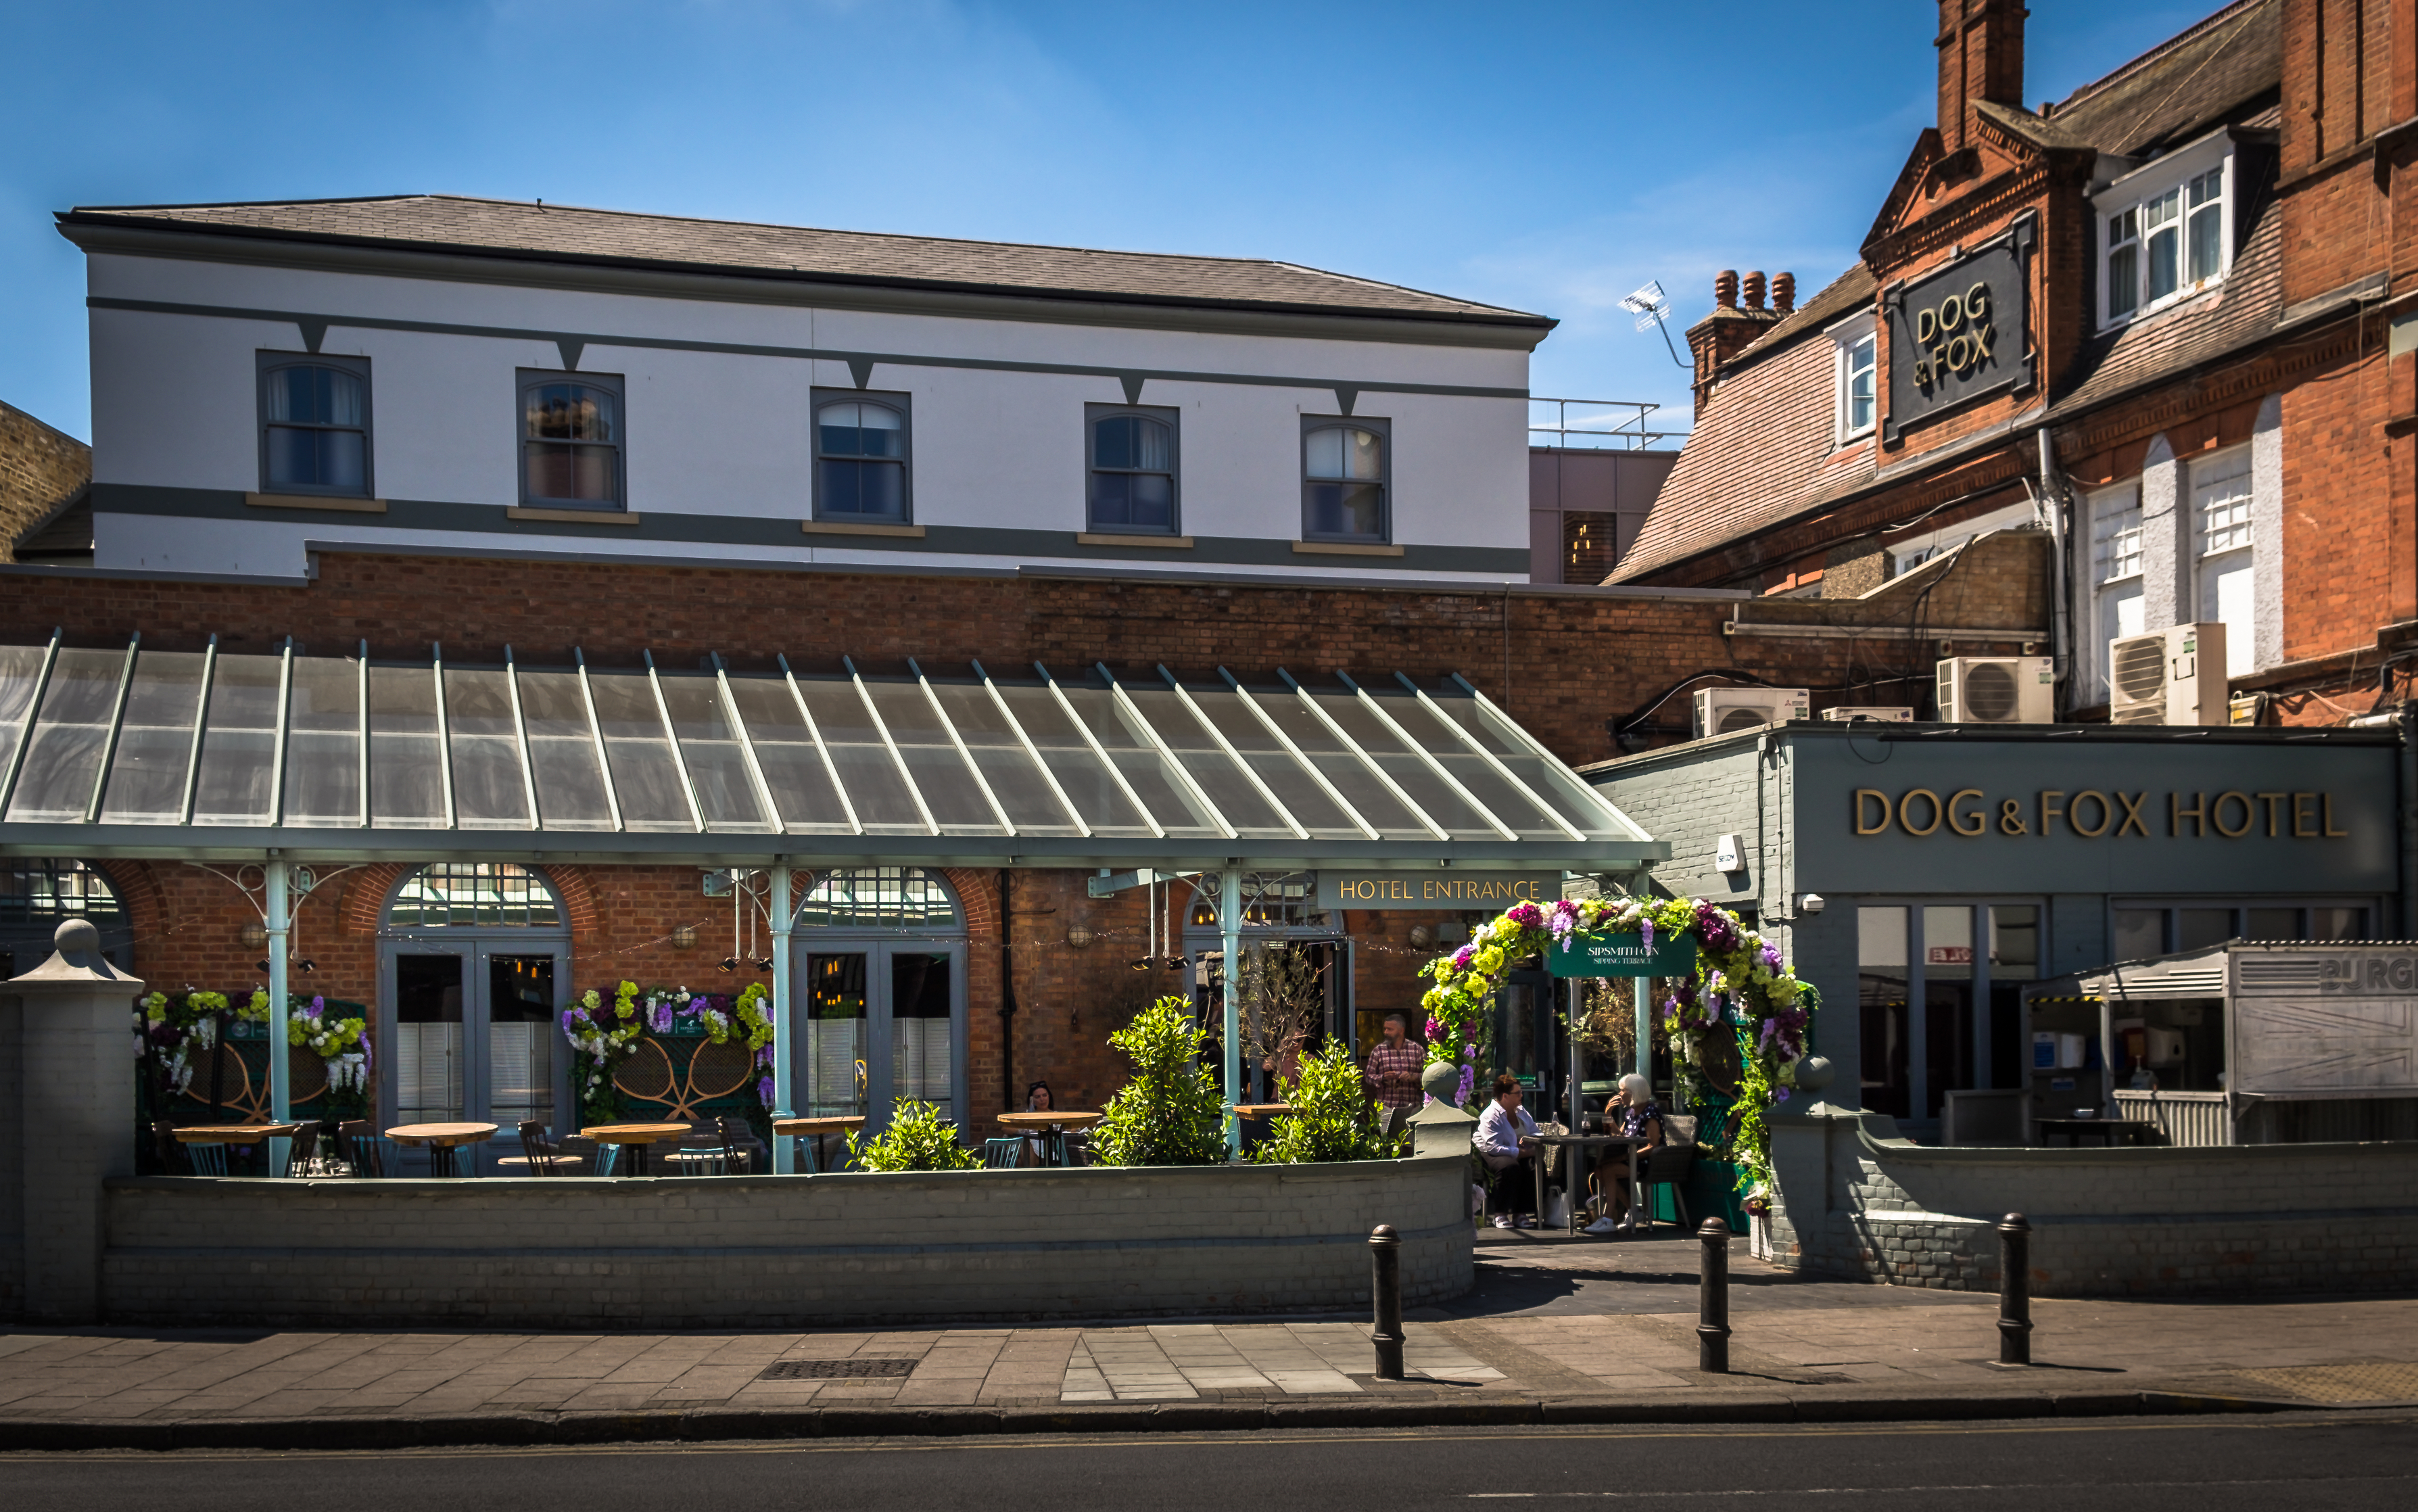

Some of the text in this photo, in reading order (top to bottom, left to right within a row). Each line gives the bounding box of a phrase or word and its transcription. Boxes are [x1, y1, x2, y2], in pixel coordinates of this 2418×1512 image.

[1918, 281, 1985, 344] DOG
[1913, 323, 1991, 387] & FOX
[1855, 788, 2349, 837] DOG & FOX HOTEL
[1340, 880, 1540, 899] HOTEL ENTRANCE
[1587, 947, 1659, 956] SIPSMITH GN
[2319, 958, 2418, 990] BURG
